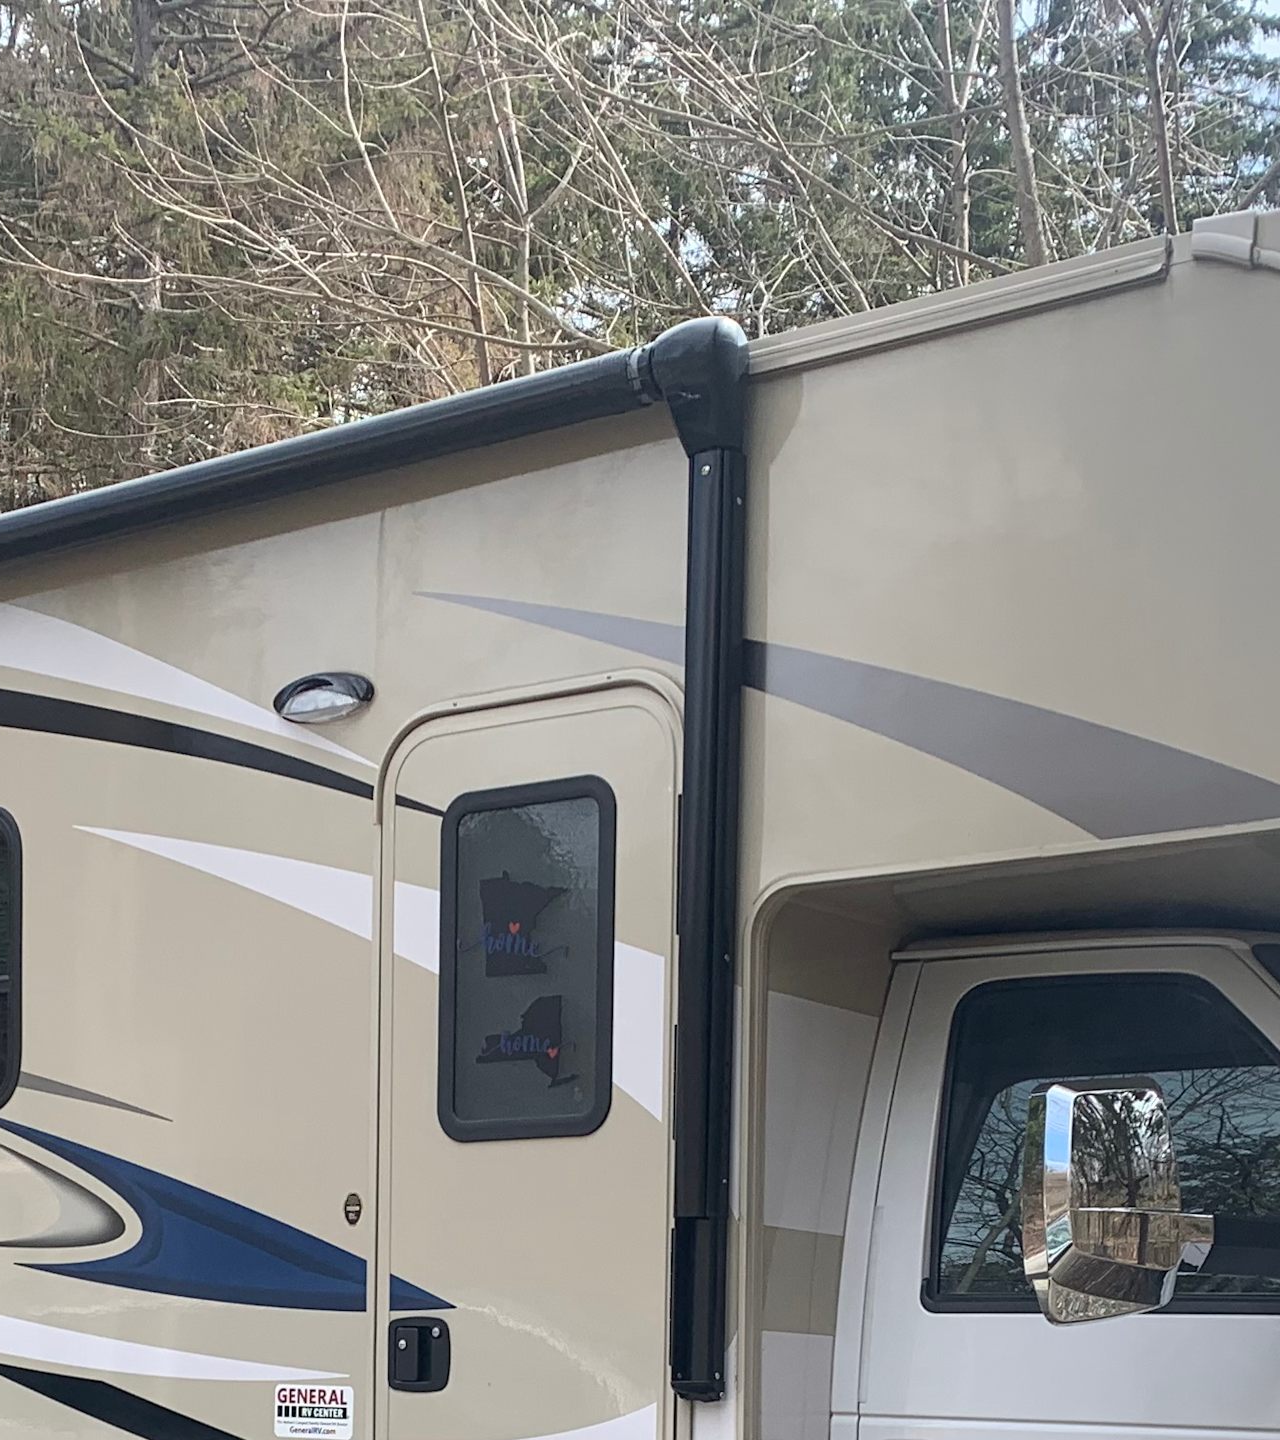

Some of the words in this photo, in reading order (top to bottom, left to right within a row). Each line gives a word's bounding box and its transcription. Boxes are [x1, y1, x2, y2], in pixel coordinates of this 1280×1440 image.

[277, 1388, 347, 1405] GENERAL
[301, 1407, 313, 1417] RV
[313, 1408, 344, 1418] CENTER
[289, 1425, 336, 1435] GeneralRV.com
